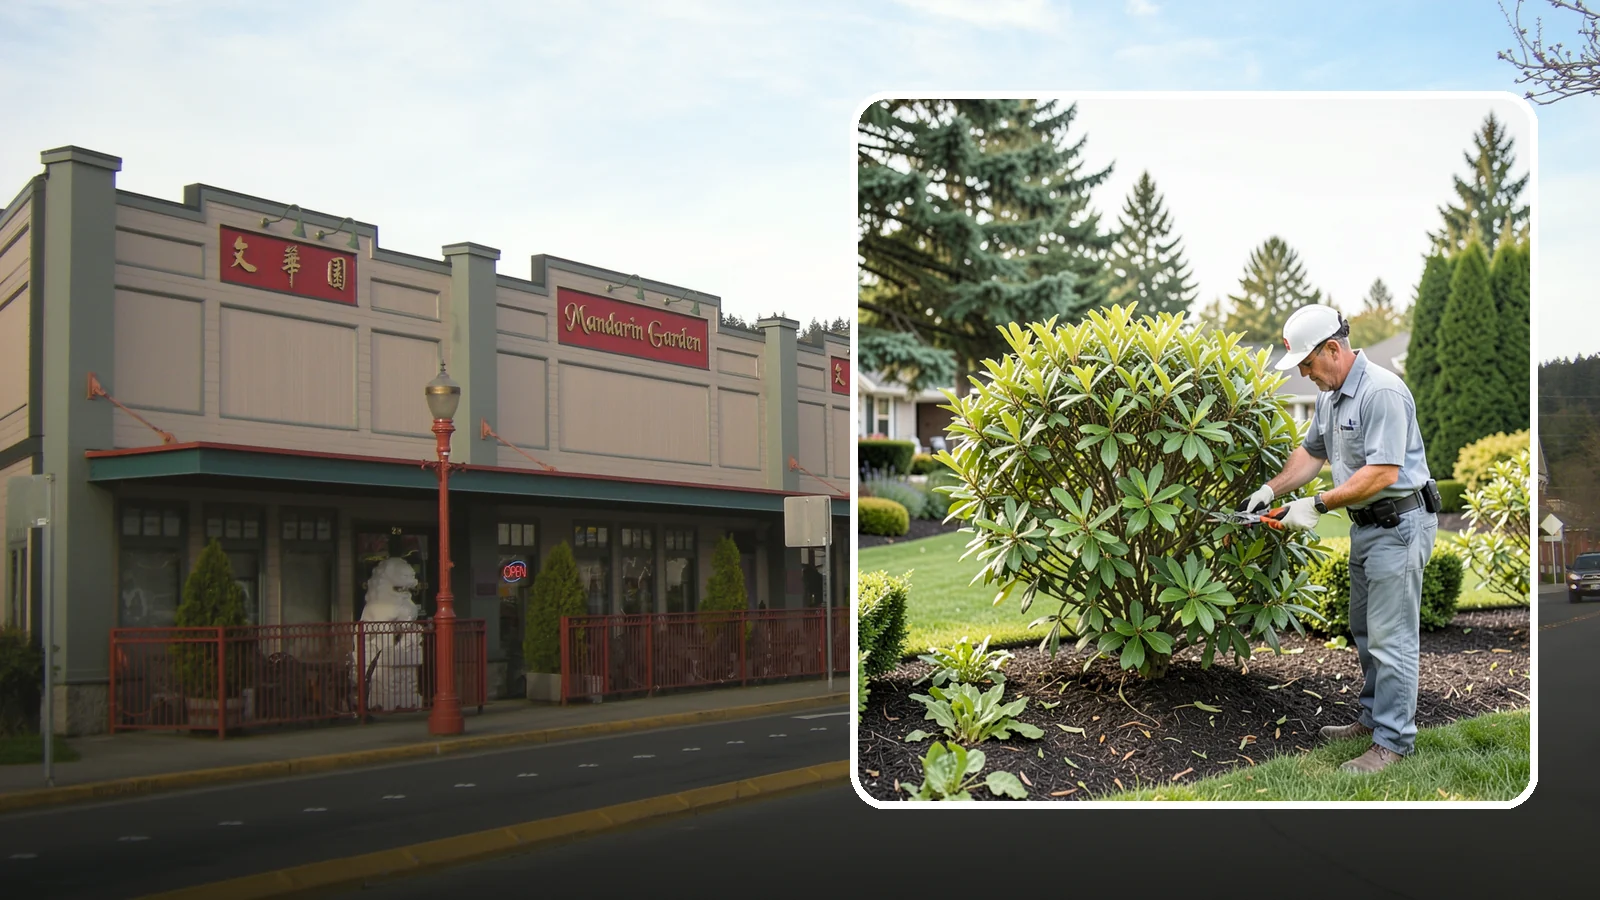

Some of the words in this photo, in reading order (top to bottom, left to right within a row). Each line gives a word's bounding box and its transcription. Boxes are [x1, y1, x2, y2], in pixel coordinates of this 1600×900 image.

[230, 235, 346, 291] 文華園
[564, 302, 644, 341] Mandarin
[648, 320, 701, 352] Garden
[503, 565, 527, 578] OPEN
